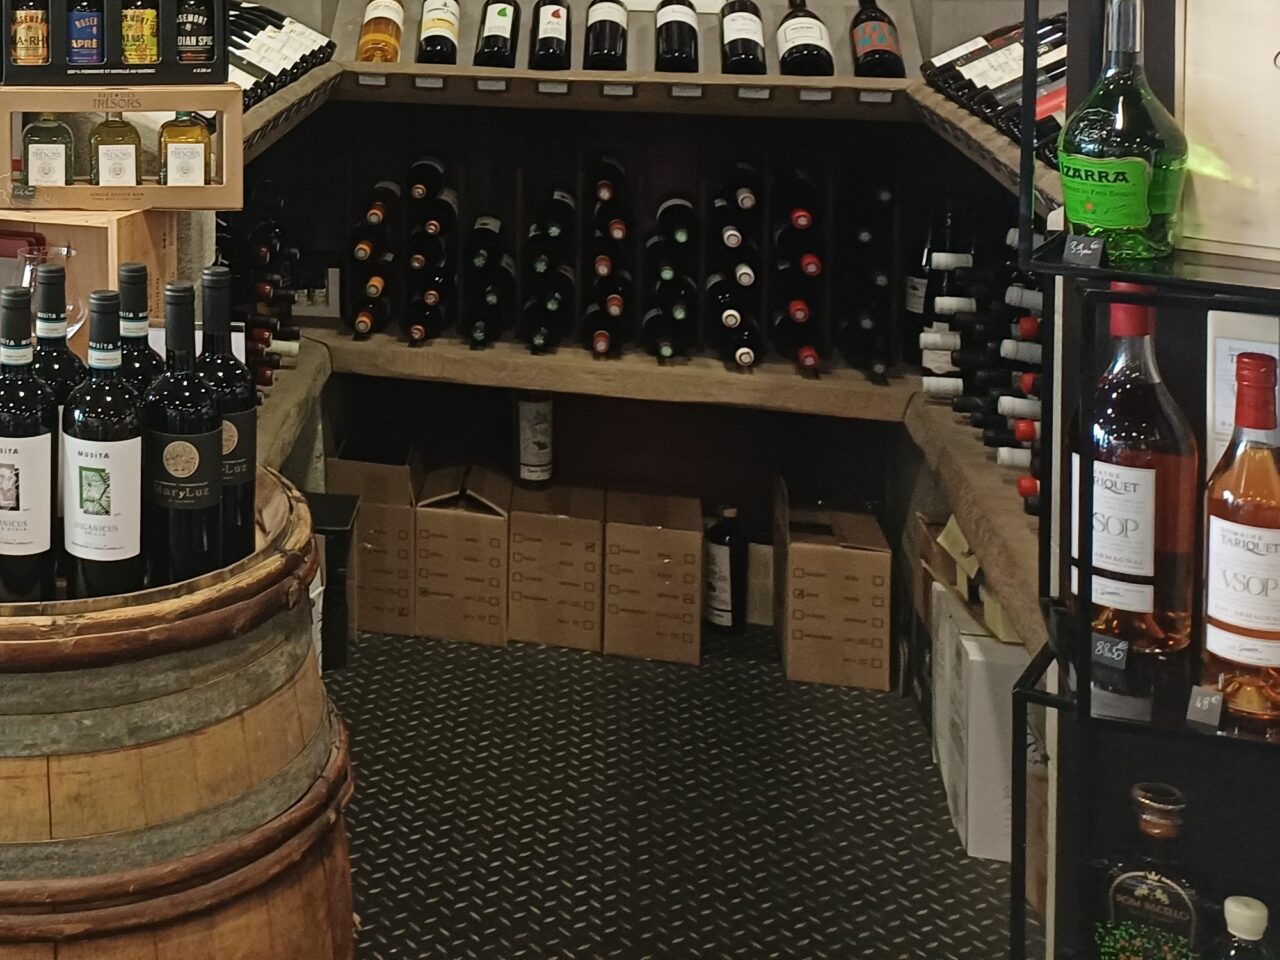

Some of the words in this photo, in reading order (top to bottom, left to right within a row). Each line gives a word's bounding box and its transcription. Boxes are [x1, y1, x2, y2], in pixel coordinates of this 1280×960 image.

[1061, 162, 1129, 184] IZARRA
[1221, 534, 1280, 556] TARIQUET
[1222, 569, 1279, 597] VSOP
